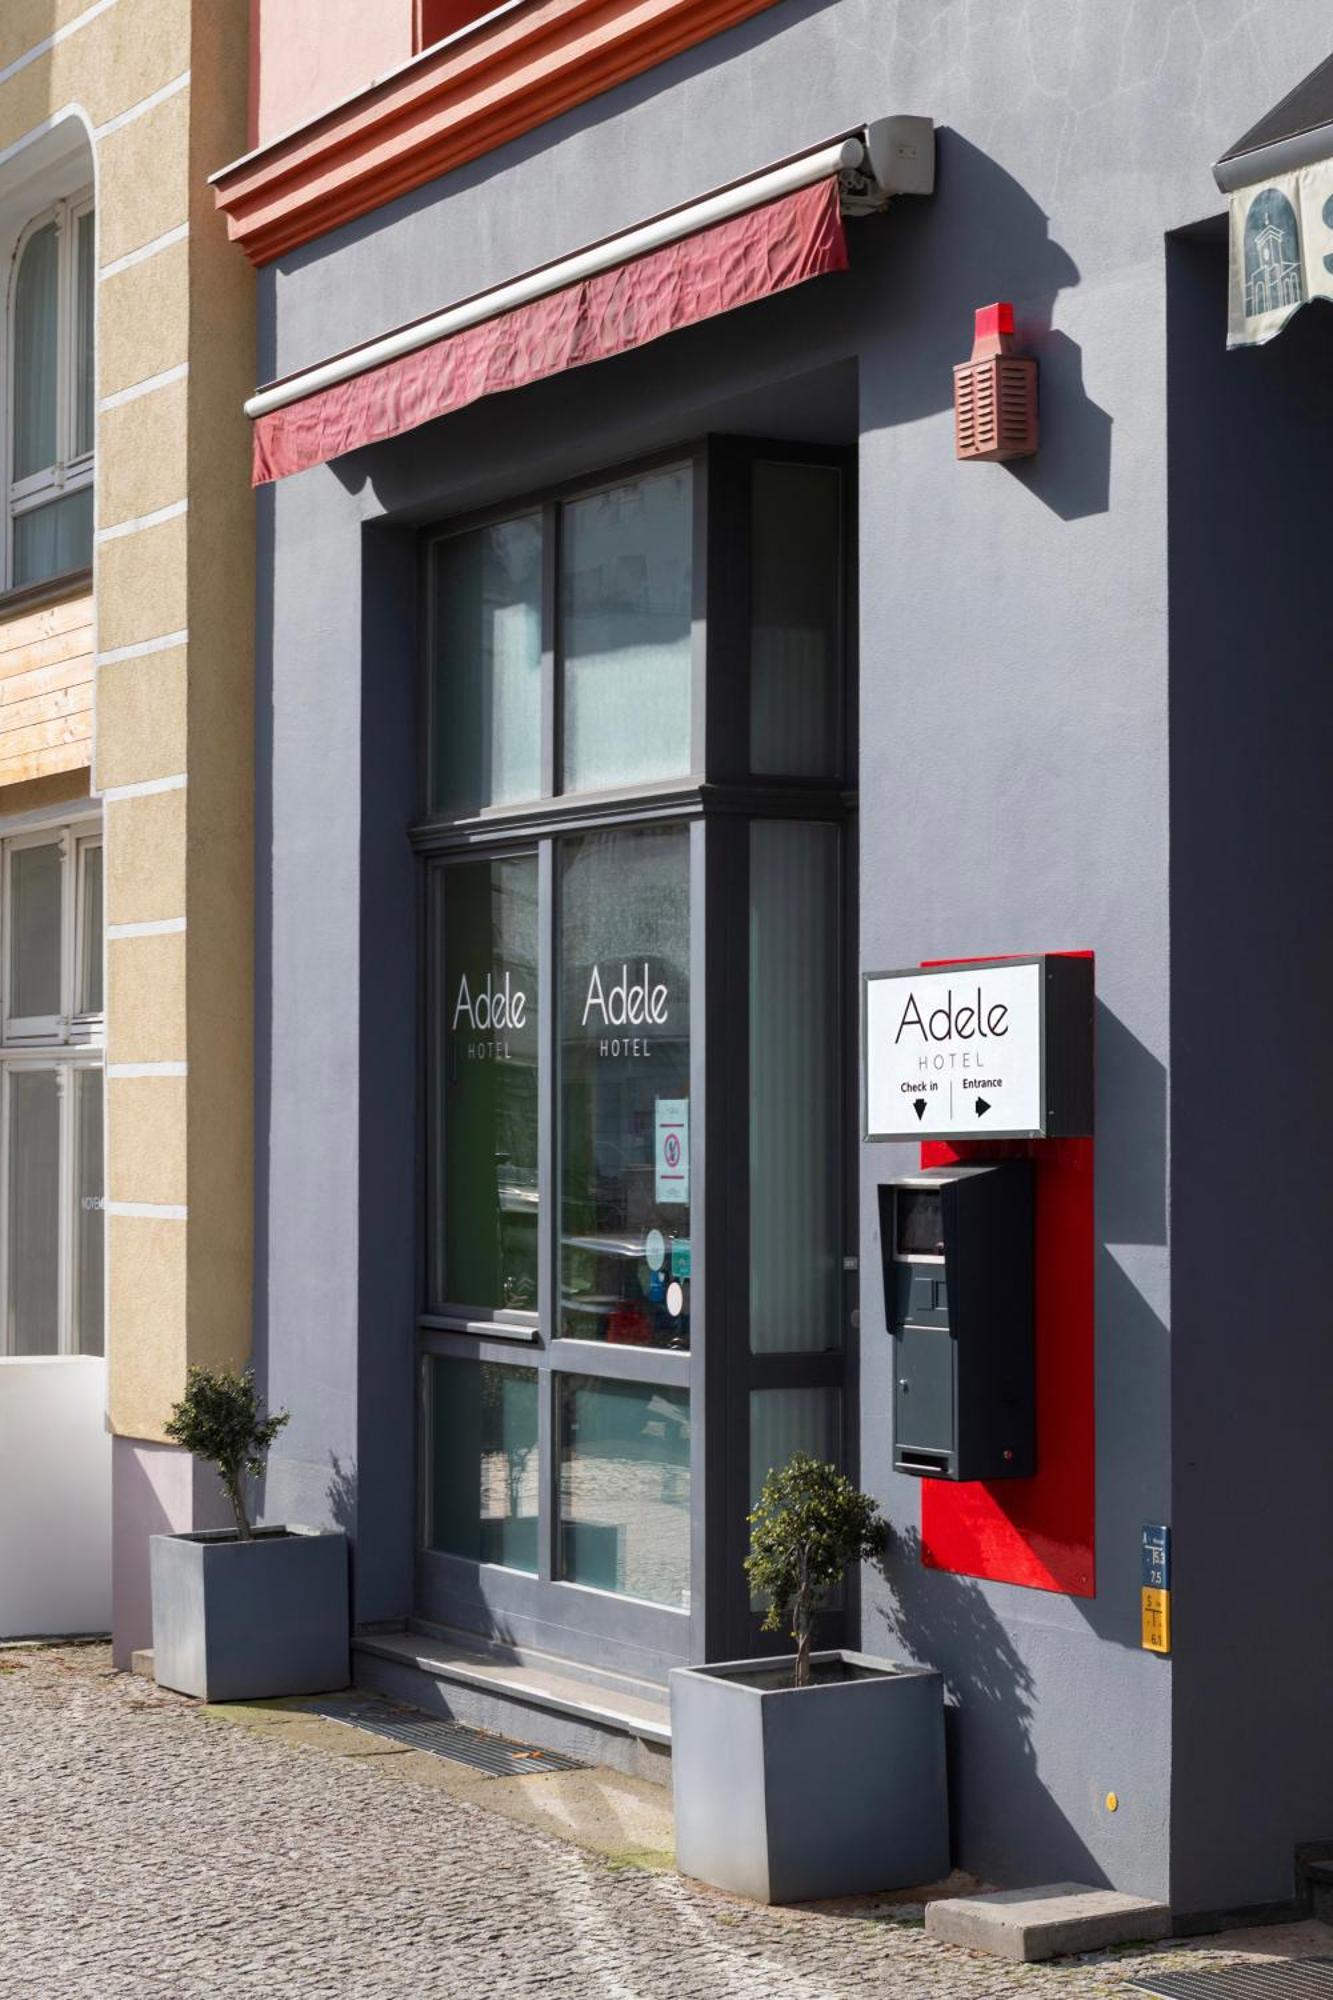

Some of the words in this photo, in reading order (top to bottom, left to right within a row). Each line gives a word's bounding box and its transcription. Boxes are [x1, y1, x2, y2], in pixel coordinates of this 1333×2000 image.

[452, 971, 526, 1031] Adele
[582, 962, 669, 1026] Adele
[894, 987, 1009, 1044] Adele
[468, 1042, 512, 1059] HOTEL
[600, 1038, 651, 1057] HOTEL
[918, 1051, 985, 1071] HOTEL
[900, 1081, 928, 1093] Check
[929, 1081, 939, 1092] in
[962, 1078, 1003, 1090] Entrance
